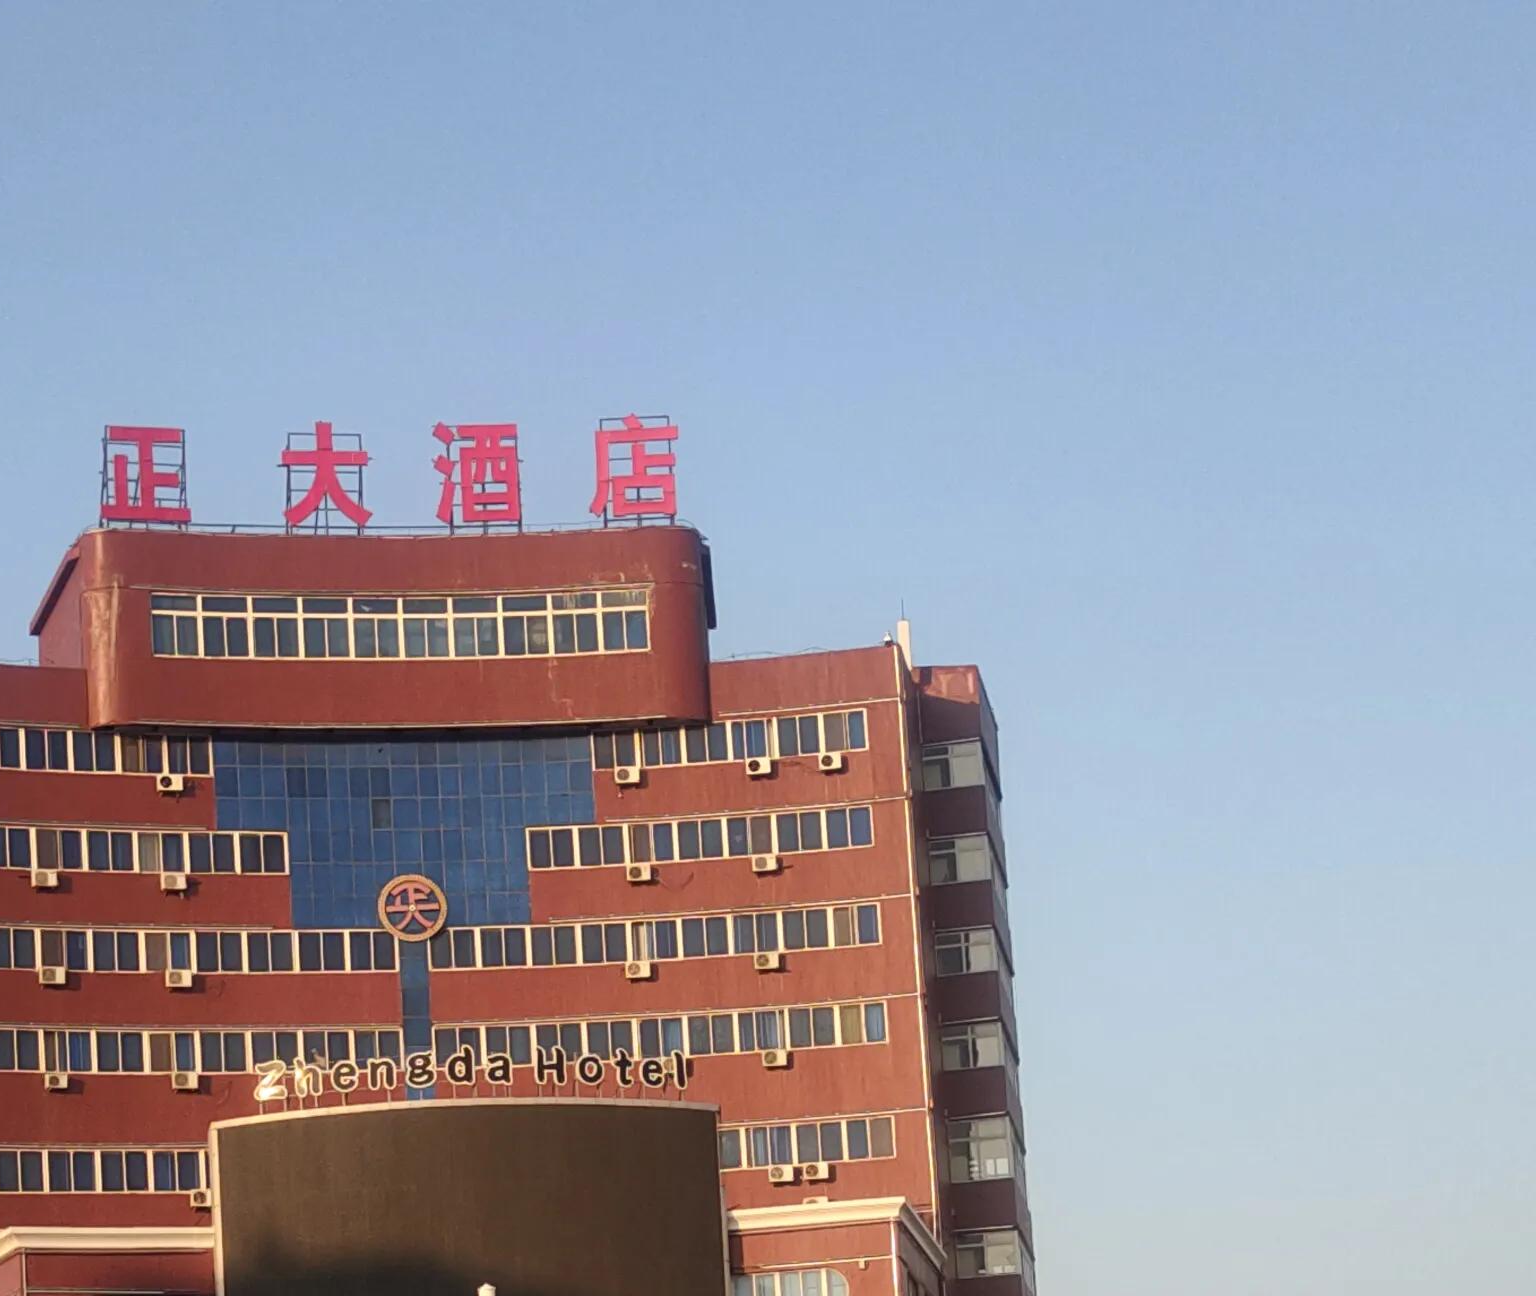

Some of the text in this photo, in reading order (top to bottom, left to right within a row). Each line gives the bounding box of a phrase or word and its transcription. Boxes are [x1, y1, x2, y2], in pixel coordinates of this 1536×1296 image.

[101, 413, 679, 527] 正大酒店
[254, 1045, 688, 1101] Zhengda Hotel
